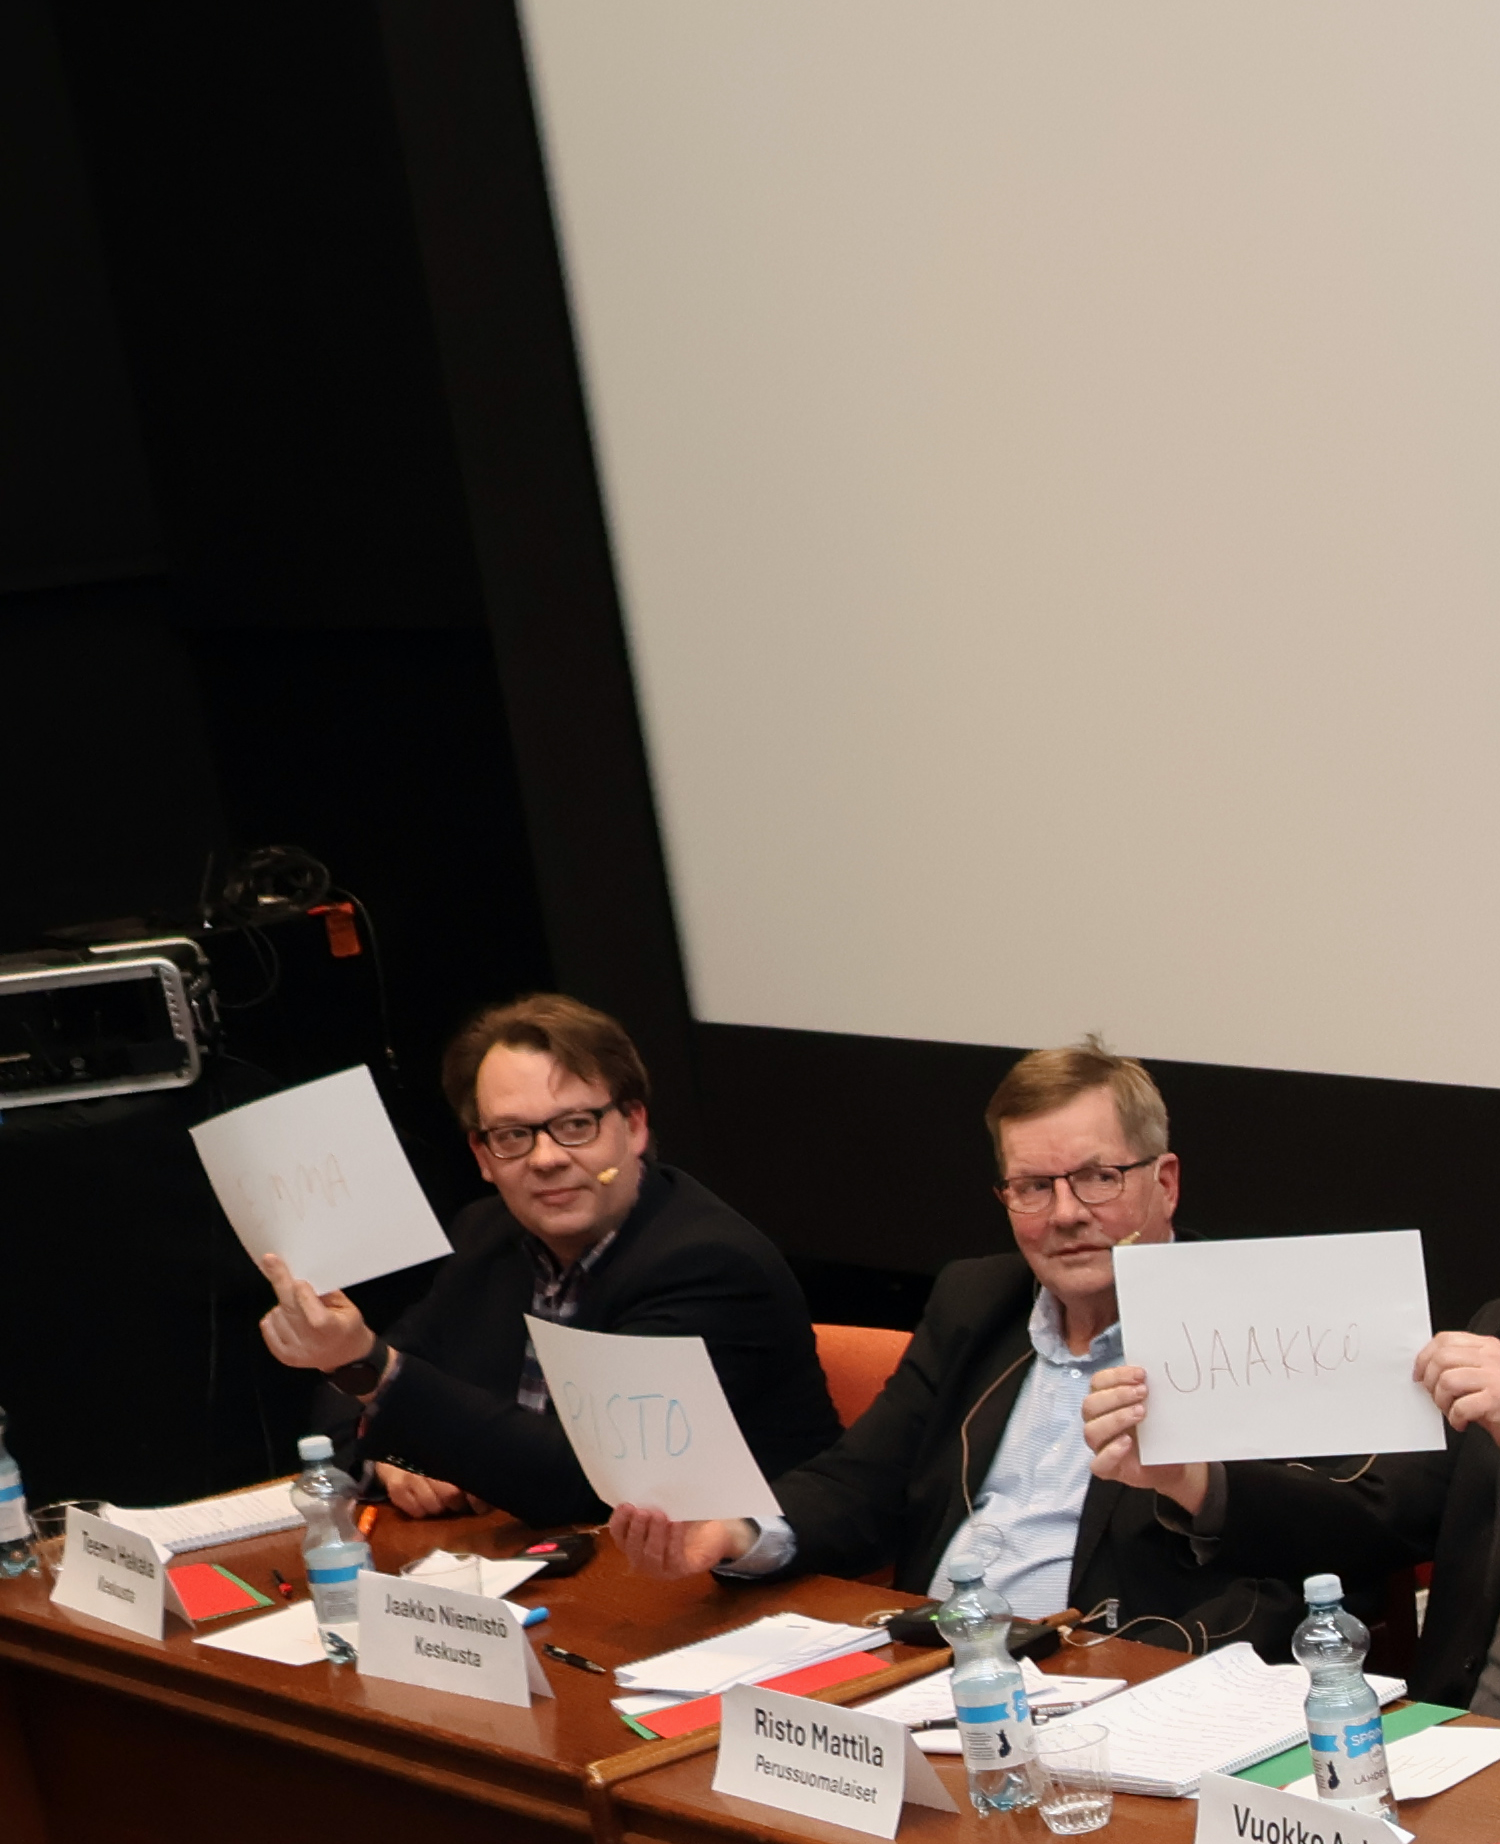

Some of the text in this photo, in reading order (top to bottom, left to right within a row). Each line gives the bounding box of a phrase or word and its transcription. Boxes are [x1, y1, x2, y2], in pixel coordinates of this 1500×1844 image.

[1163, 1321, 1361, 1394] JAAKKO
[384, 1593, 509, 1639] Jaakko Niemistö
[414, 1635, 482, 1668] Keskusta
[754, 1707, 807, 1747] Risto
[811, 1721, 884, 1768] Mattila
[754, 1753, 878, 1805] Perussuomalaiset
